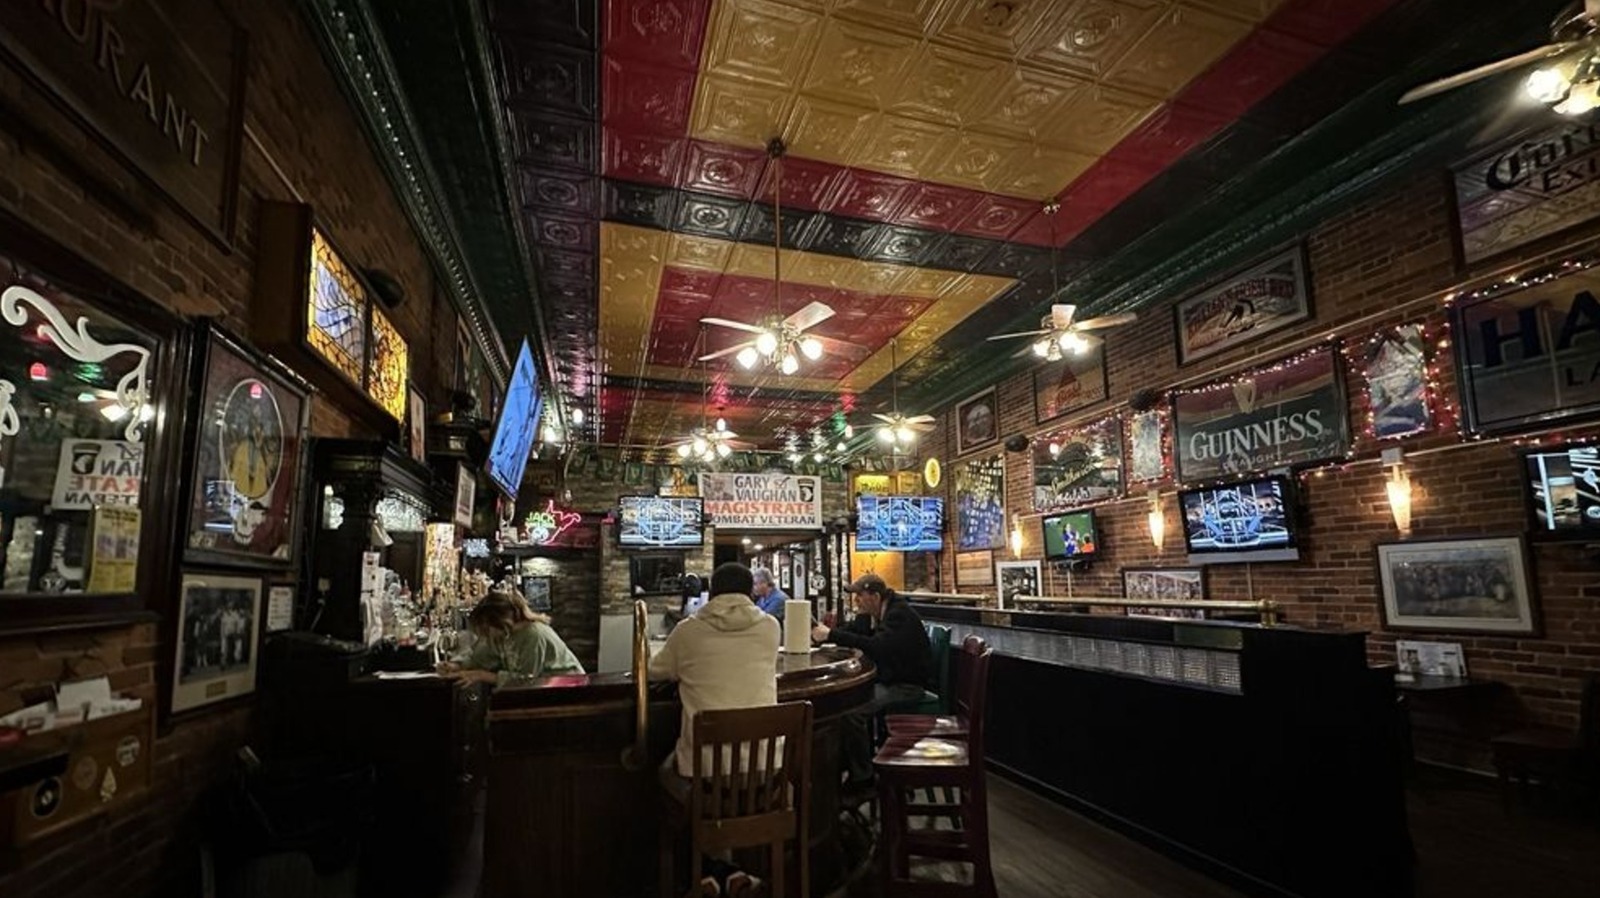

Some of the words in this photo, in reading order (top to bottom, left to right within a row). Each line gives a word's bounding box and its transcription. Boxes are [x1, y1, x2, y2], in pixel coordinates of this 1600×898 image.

[38, 0, 209, 166] URANT
[1190, 409, 1323, 461] GUINNESS
[735, 475, 770, 489] GARY
[736, 489, 797, 502] VAUGHAN
[705, 502, 814, 514] MAGISTRATE
[713, 514, 757, 524] OMBAT
[760, 516, 815, 525] VETERAN
